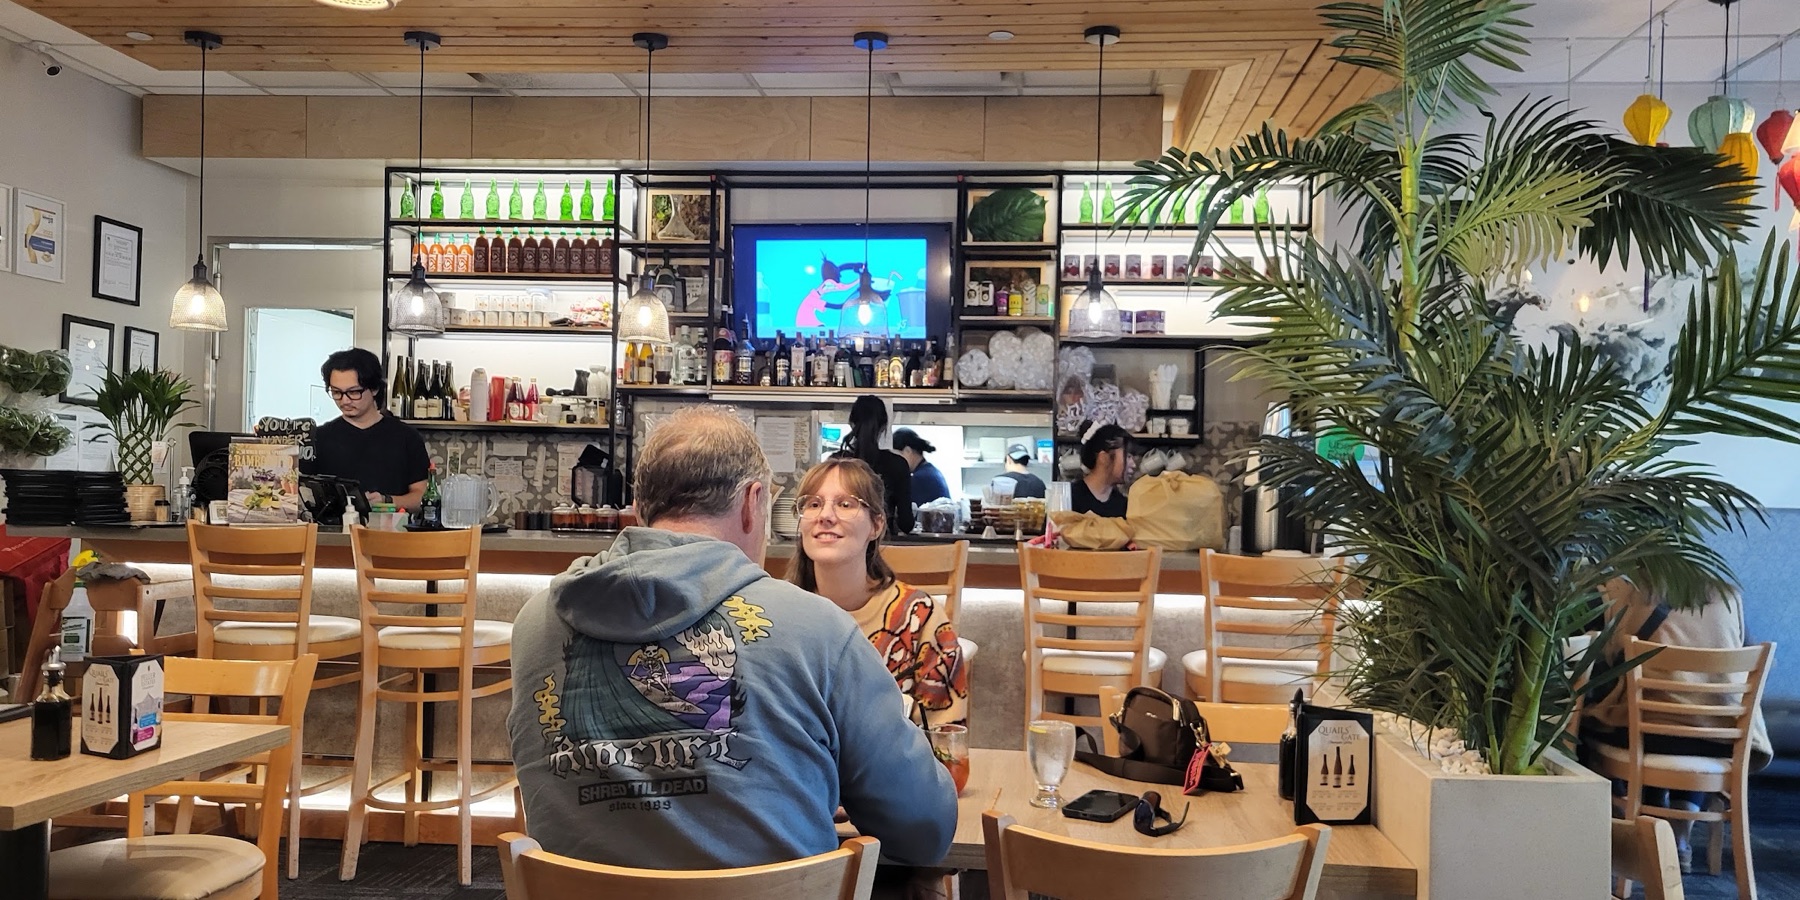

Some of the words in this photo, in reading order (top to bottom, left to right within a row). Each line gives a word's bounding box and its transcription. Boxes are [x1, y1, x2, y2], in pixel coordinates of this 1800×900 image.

[580, 784, 627, 801] SHRED
[661, 778, 706, 794] DEAD
[640, 799, 673, 811] 1989
